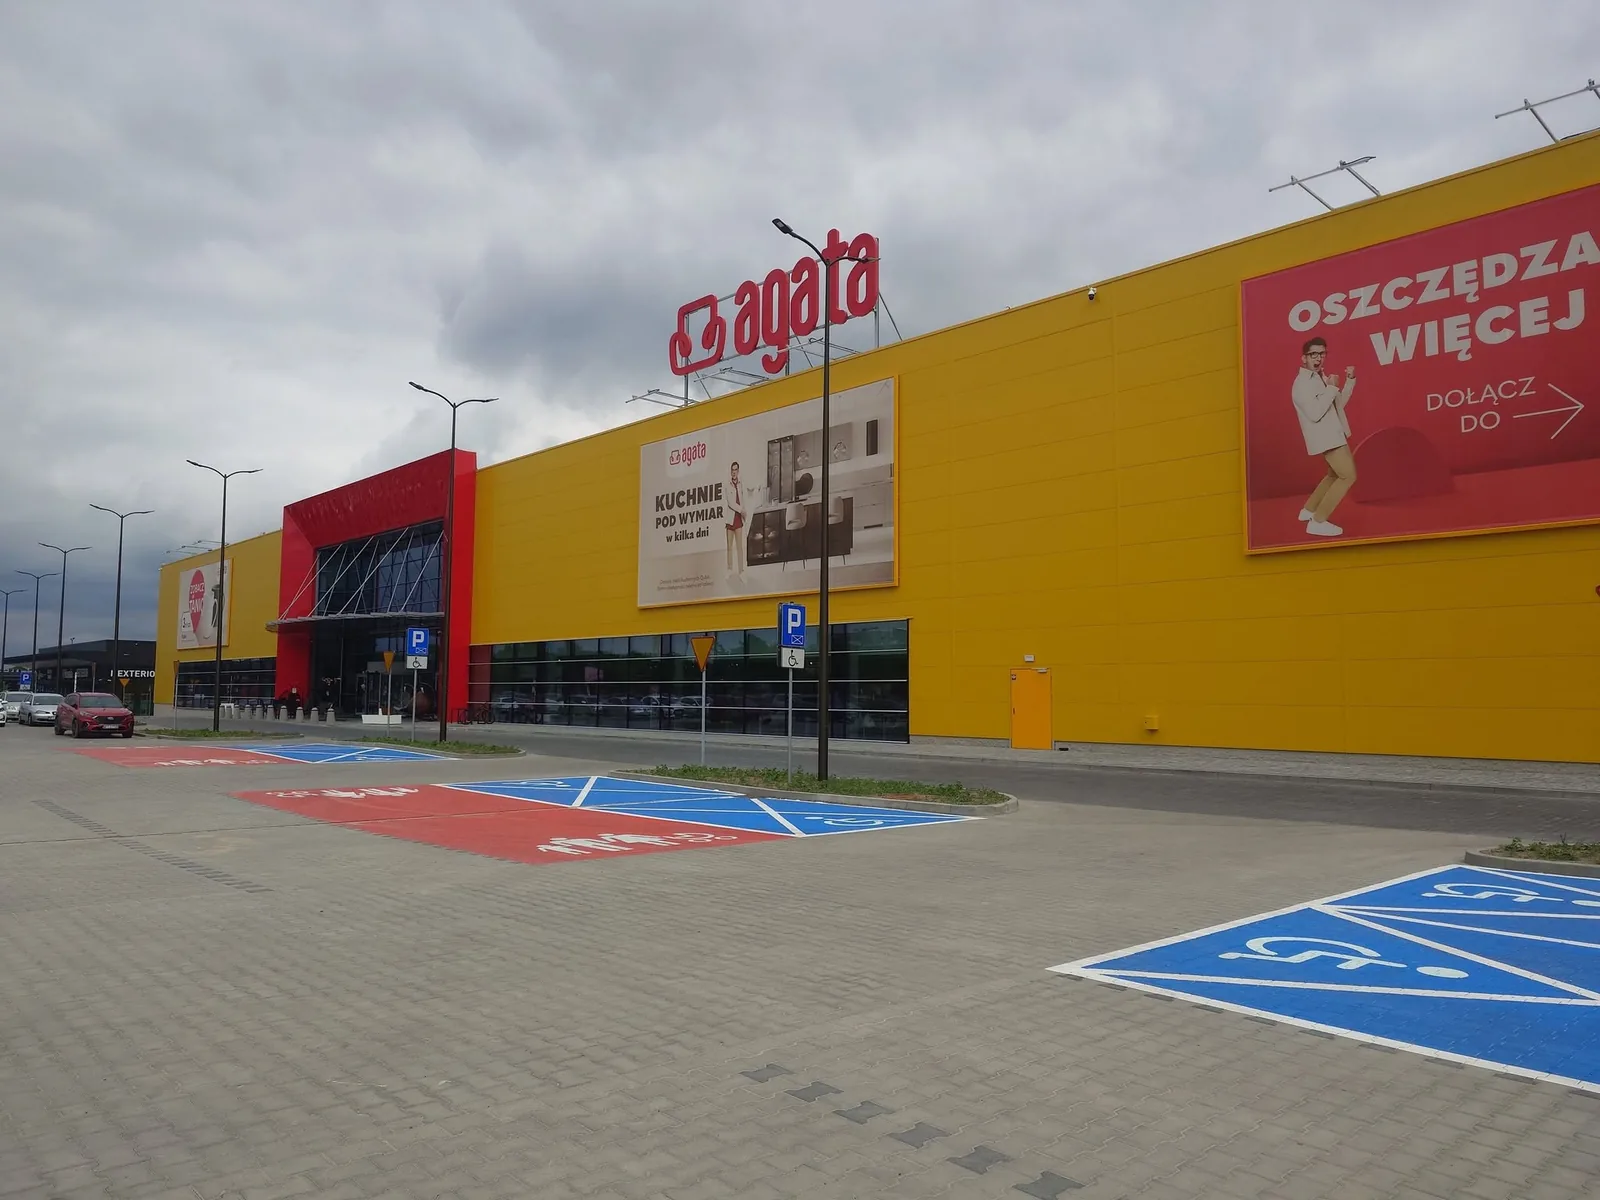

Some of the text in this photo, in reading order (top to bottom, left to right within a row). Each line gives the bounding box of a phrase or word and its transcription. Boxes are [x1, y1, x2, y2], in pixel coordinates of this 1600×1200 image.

[1288, 231, 1600, 332] OSZCZĘDZA
[734, 228, 879, 374] agata
[1369, 288, 1586, 366] WIĘCEJ
[1426, 376, 1536, 412] DOŁĄCZ
[1461, 410, 1500, 433] DO
[682, 441, 706, 467] agata
[655, 482, 723, 512] KUCHNIE
[655, 505, 724, 529] POD WYMIAR
[666, 526, 709, 543] w kilka dni
[787, 608, 801, 634] P
[412, 631, 425, 647] P
